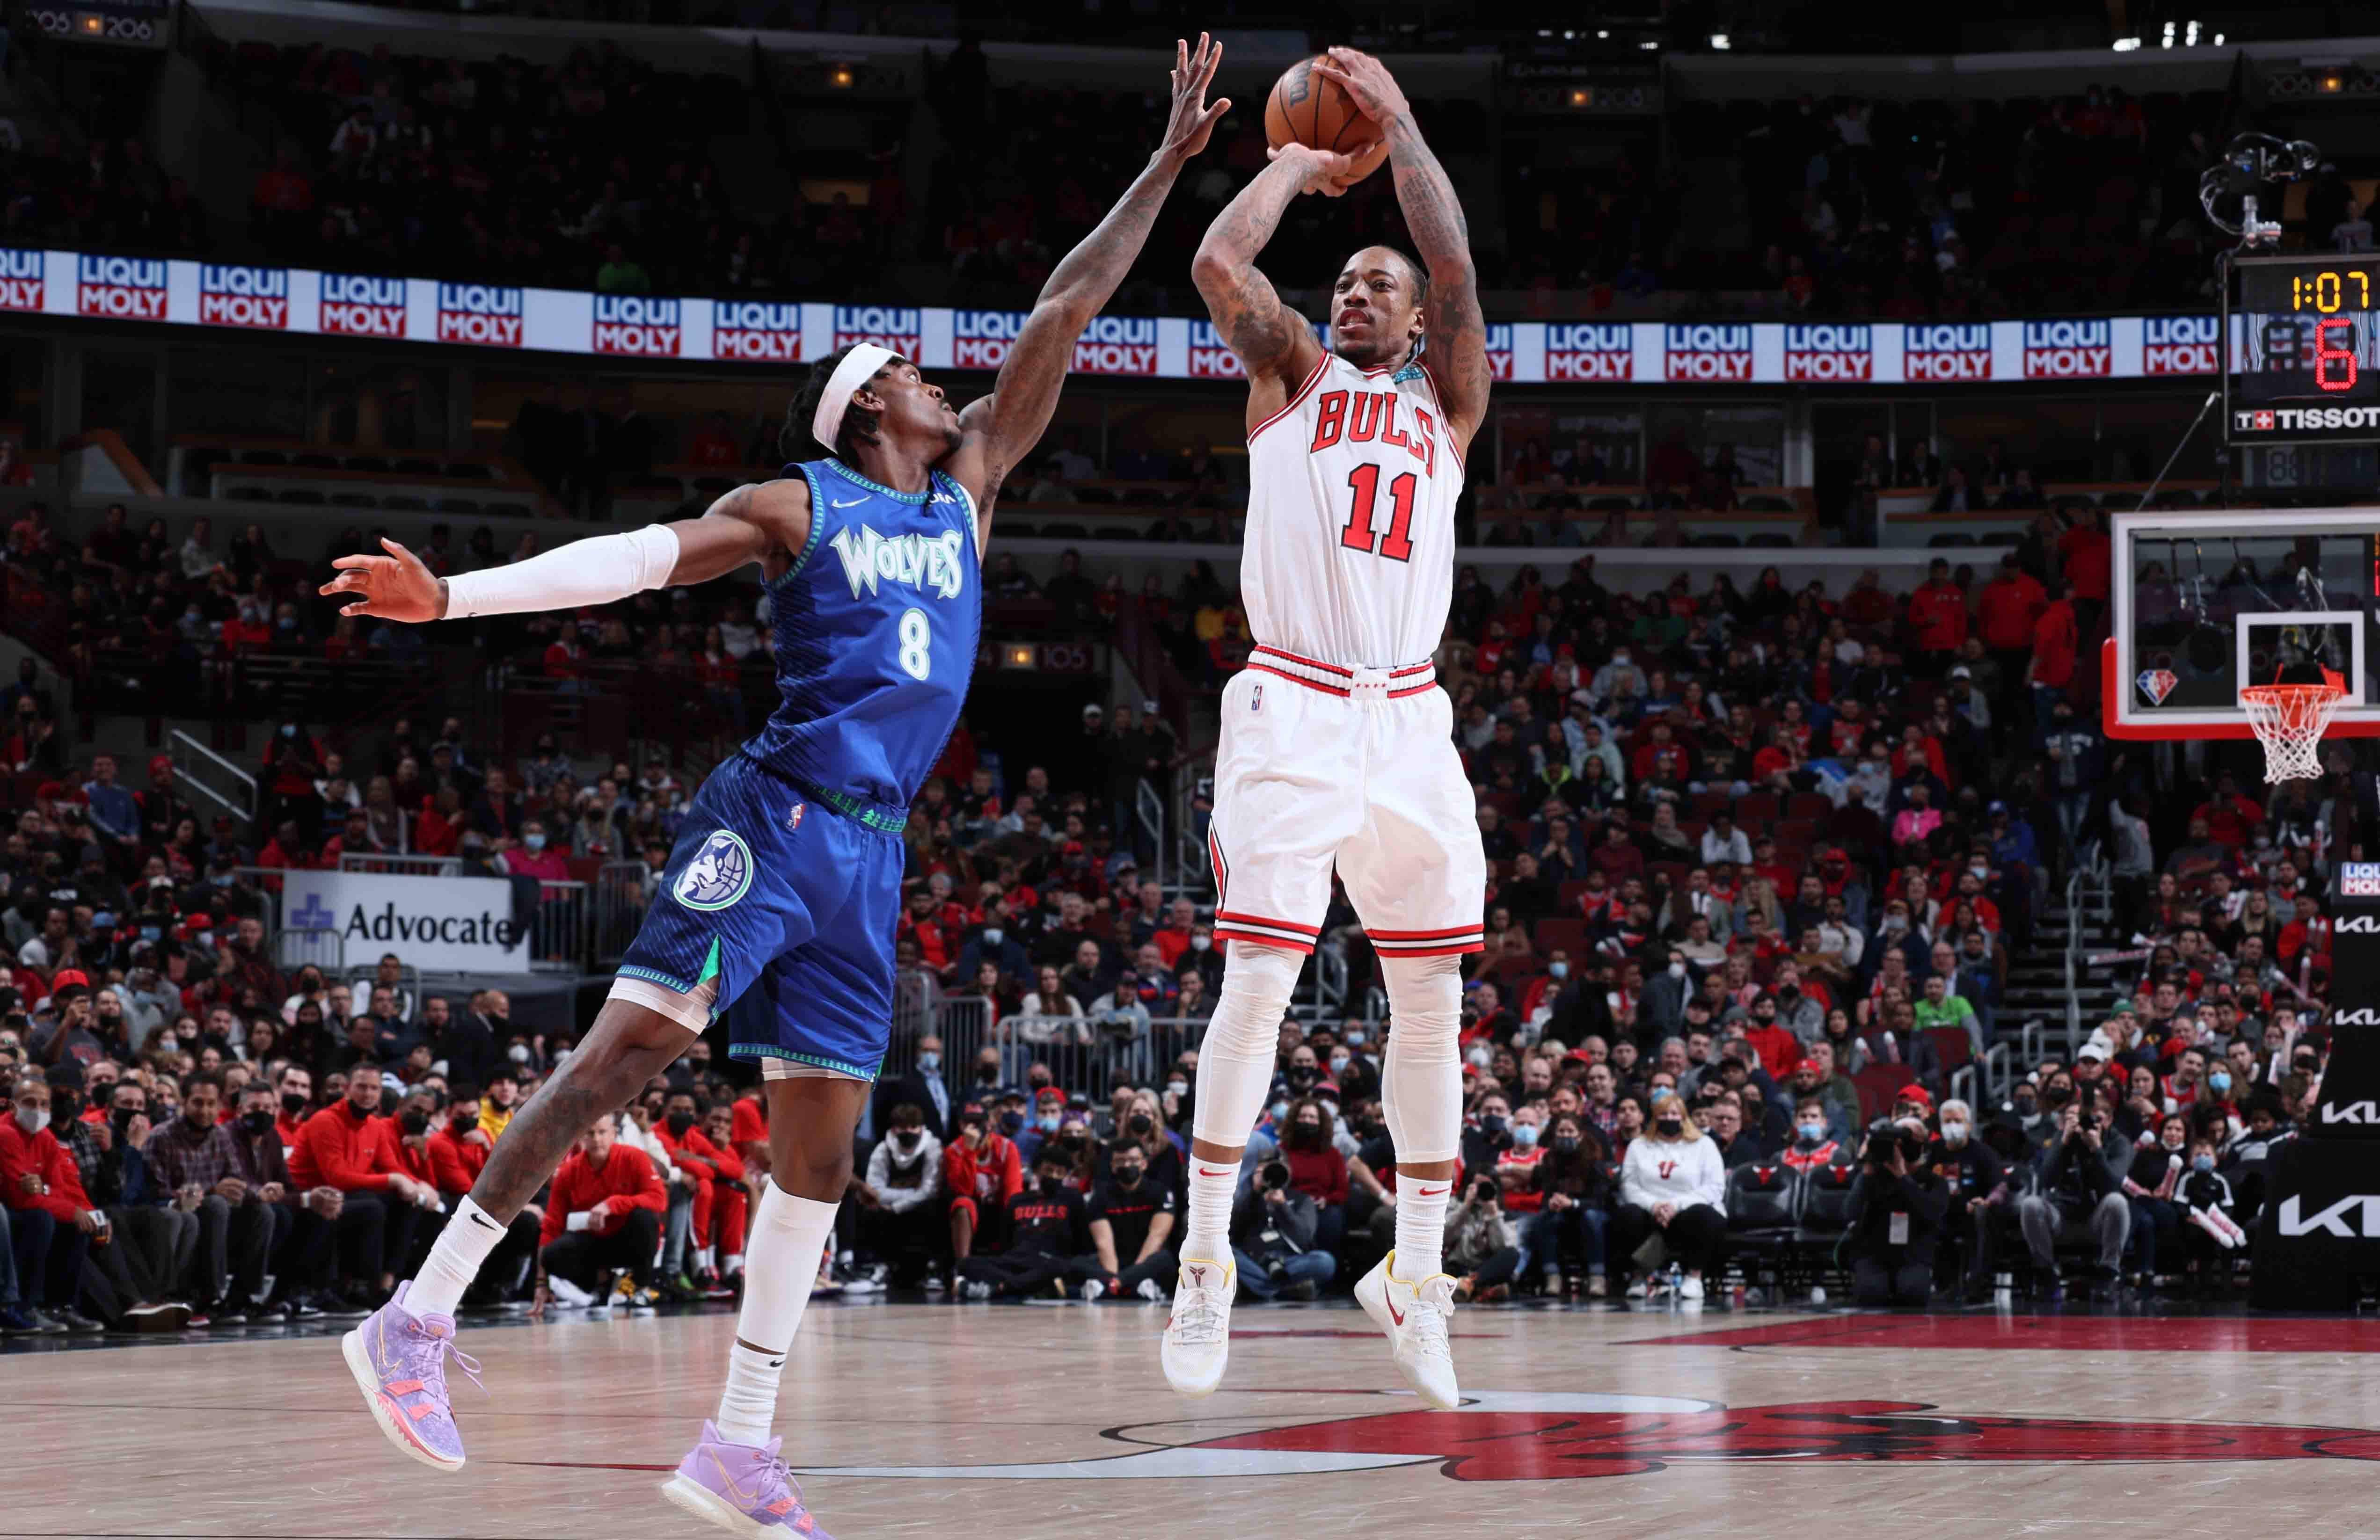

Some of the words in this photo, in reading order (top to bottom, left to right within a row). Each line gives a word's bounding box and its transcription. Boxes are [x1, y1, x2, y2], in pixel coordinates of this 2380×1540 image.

[81, 256, 164, 287] LIQUI
[204, 265, 285, 297] LIQUI
[81, 285, 165, 317] MOLY
[324, 275, 403, 306] LIQUI
[441, 283, 519, 315] LIQUI
[2293, 271, 2369, 313] 1:07
[203, 294, 286, 326] MOLY
[324, 303, 404, 335] MOLY
[597, 295, 677, 325] LIQUI
[716, 302, 798, 330] LIQUI
[838, 307, 918, 334] LIQUI
[441, 312, 521, 344] MOLY
[597, 324, 679, 354] MOLY
[957, 312, 1029, 339] LIQU
[1548, 325, 1629, 351] LIQUI
[1669, 325, 1749, 351] LIQUI
[1789, 325, 1868, 351] LIQUI
[1908, 325, 1988, 352] LIQUI
[2027, 320, 2106, 349] LIQUI
[2147, 317, 2219, 344] LIQU
[716, 331, 800, 359] MOLY
[1076, 344, 1155, 373] MOLY
[2315, 318, 2357, 391] 6
[1548, 353, 1630, 378] MOLY
[1669, 353, 1751, 378] MOLY
[1788, 353, 1870, 378] MOLY
[1907, 352, 1989, 379] MOLY
[2027, 349, 2109, 376] MOLY
[2276, 407, 2380, 430] TISSOT
[1341, 463, 1417, 563] 11
[898, 607, 931, 681] 8
[345, 902, 512, 946] Advocate
[1014, 1205, 1068, 1220] BULLS
